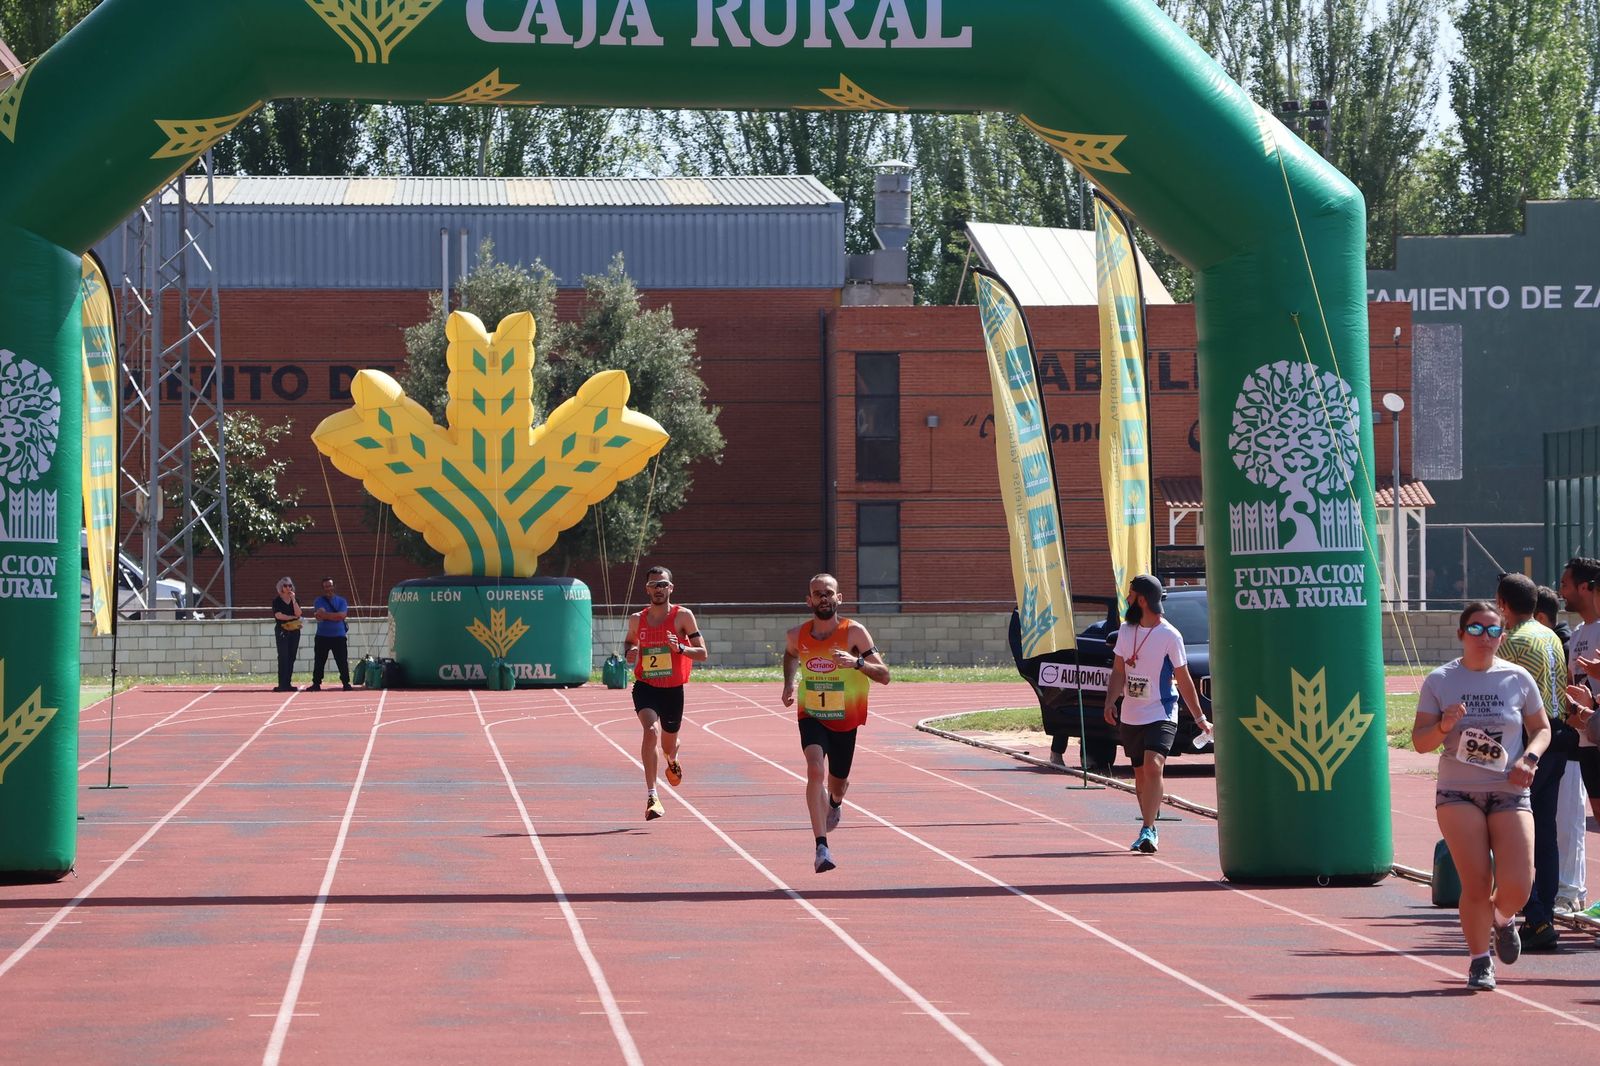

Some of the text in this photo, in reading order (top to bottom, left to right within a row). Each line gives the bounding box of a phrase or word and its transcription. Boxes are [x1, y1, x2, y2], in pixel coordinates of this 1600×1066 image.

[465, 0, 973, 49] CAJA RURAL
[1521, 285, 1562, 309] DE
[329, 365, 396, 400] D
[0, 554, 58, 576] CION
[1233, 564, 1365, 588] FUNDACION
[430, 588, 462, 602] LEÓN
[486, 589, 544, 601] OURENSE
[1234, 586, 1367, 611] CAJA RURAL
[650, 655, 658, 668] 2
[809, 661, 834, 669] Serrano
[438, 664, 487, 680] CAJA
[1061, 669, 1110, 687] AUTOMÓV
[818, 691, 825, 707] 1
[1465, 730, 1478, 738] 10K
[1465, 739, 1502, 759] 948
